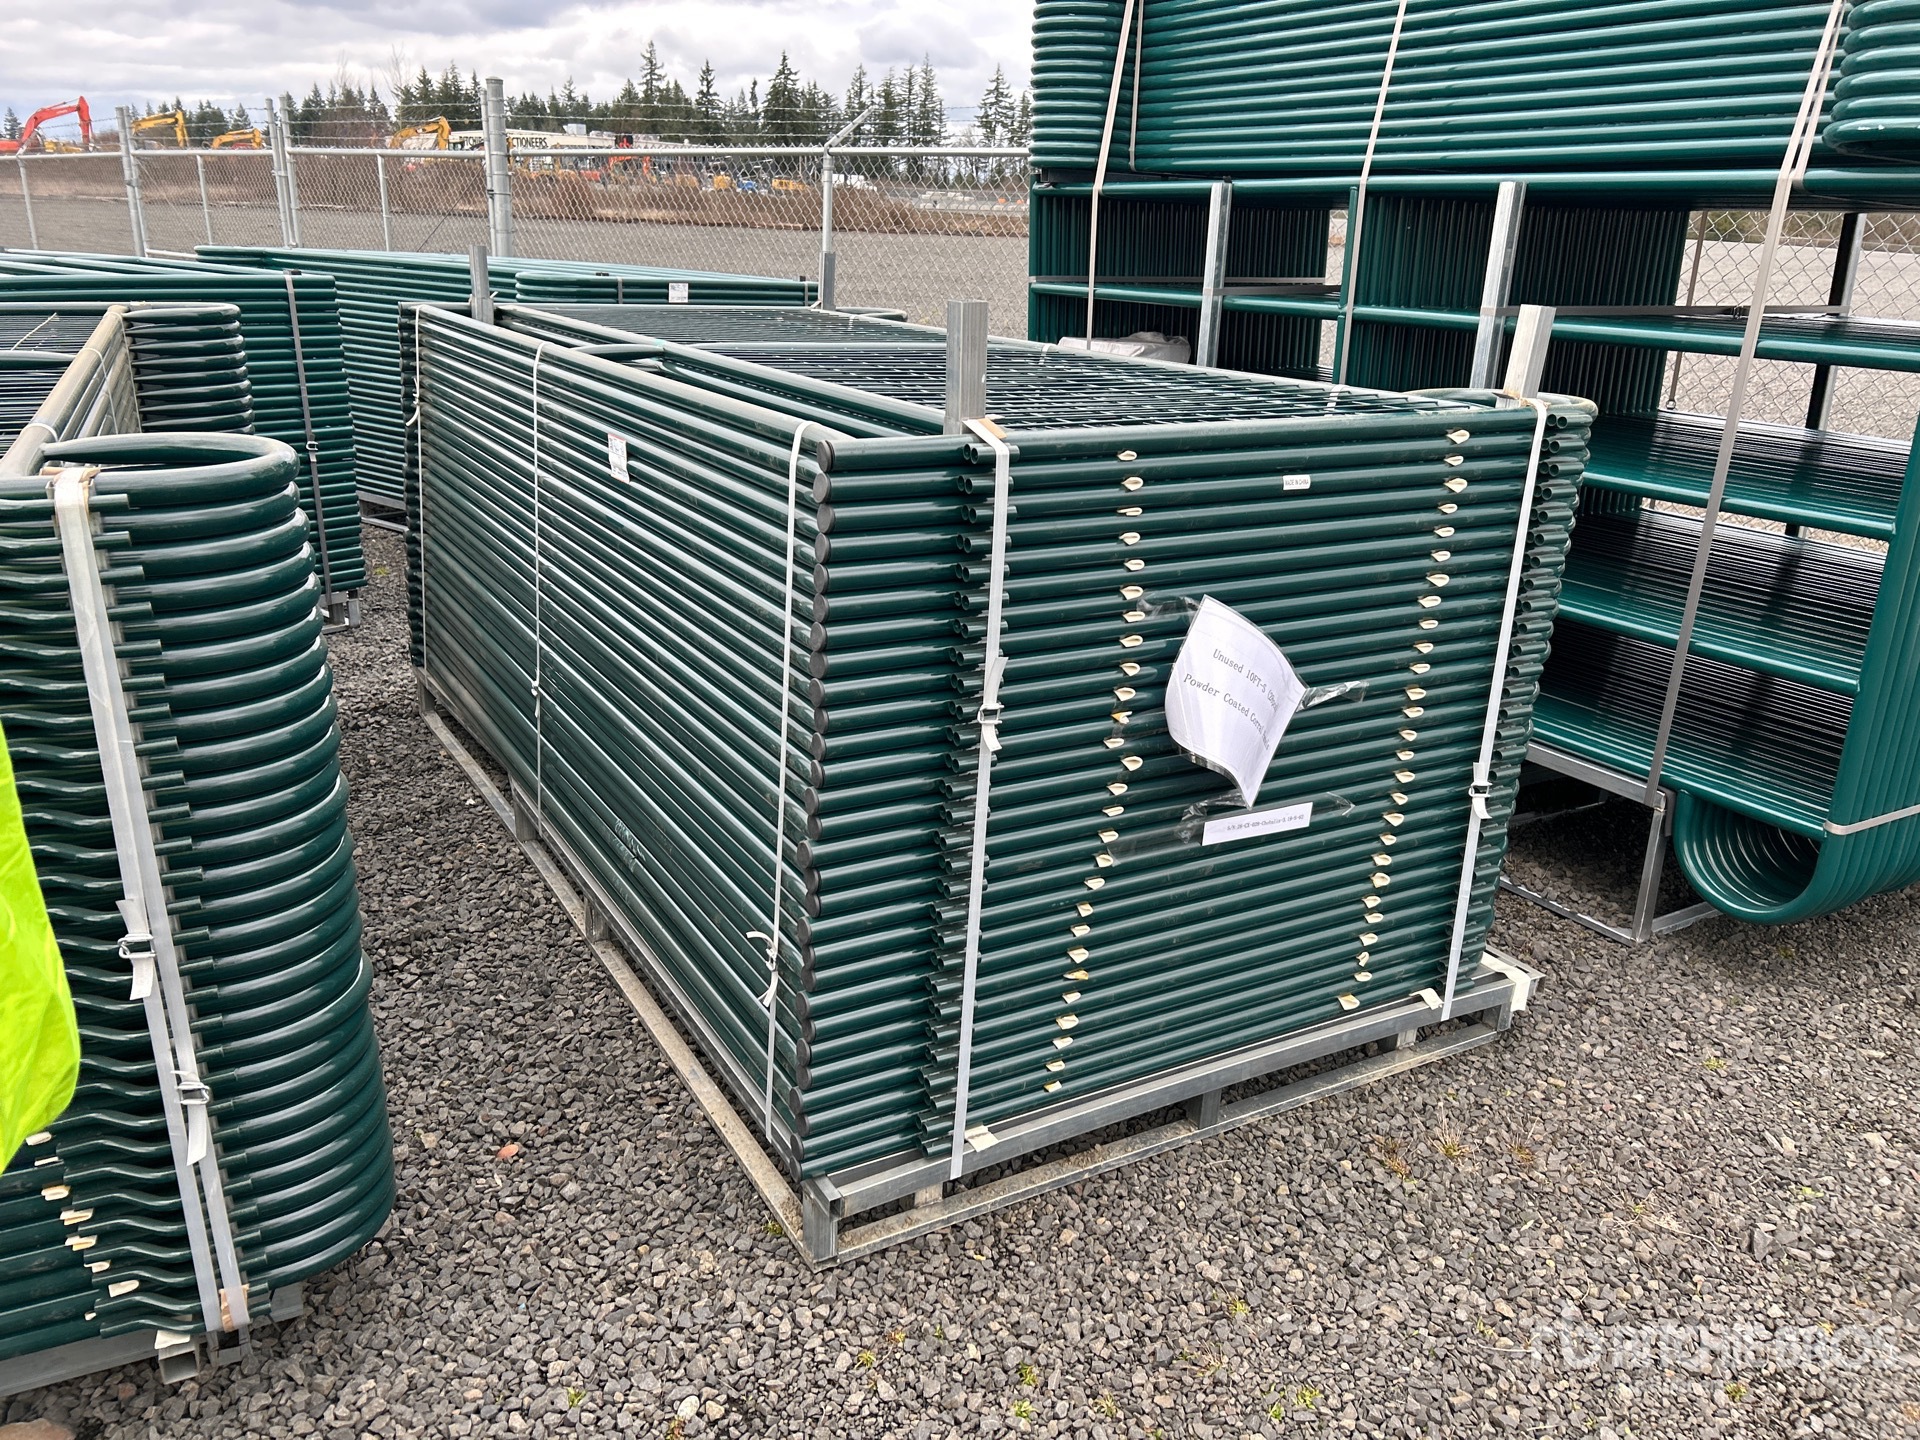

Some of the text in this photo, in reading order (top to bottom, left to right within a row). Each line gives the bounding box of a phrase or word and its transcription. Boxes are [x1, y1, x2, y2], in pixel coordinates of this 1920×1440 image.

[511, 137, 548, 148] CTIONEERS
[1213, 648, 1244, 673] Unused
[1183, 673, 1220, 697] Powder
[1223, 692, 1250, 717] Coated
[1250, 713, 1265, 735] Corral
